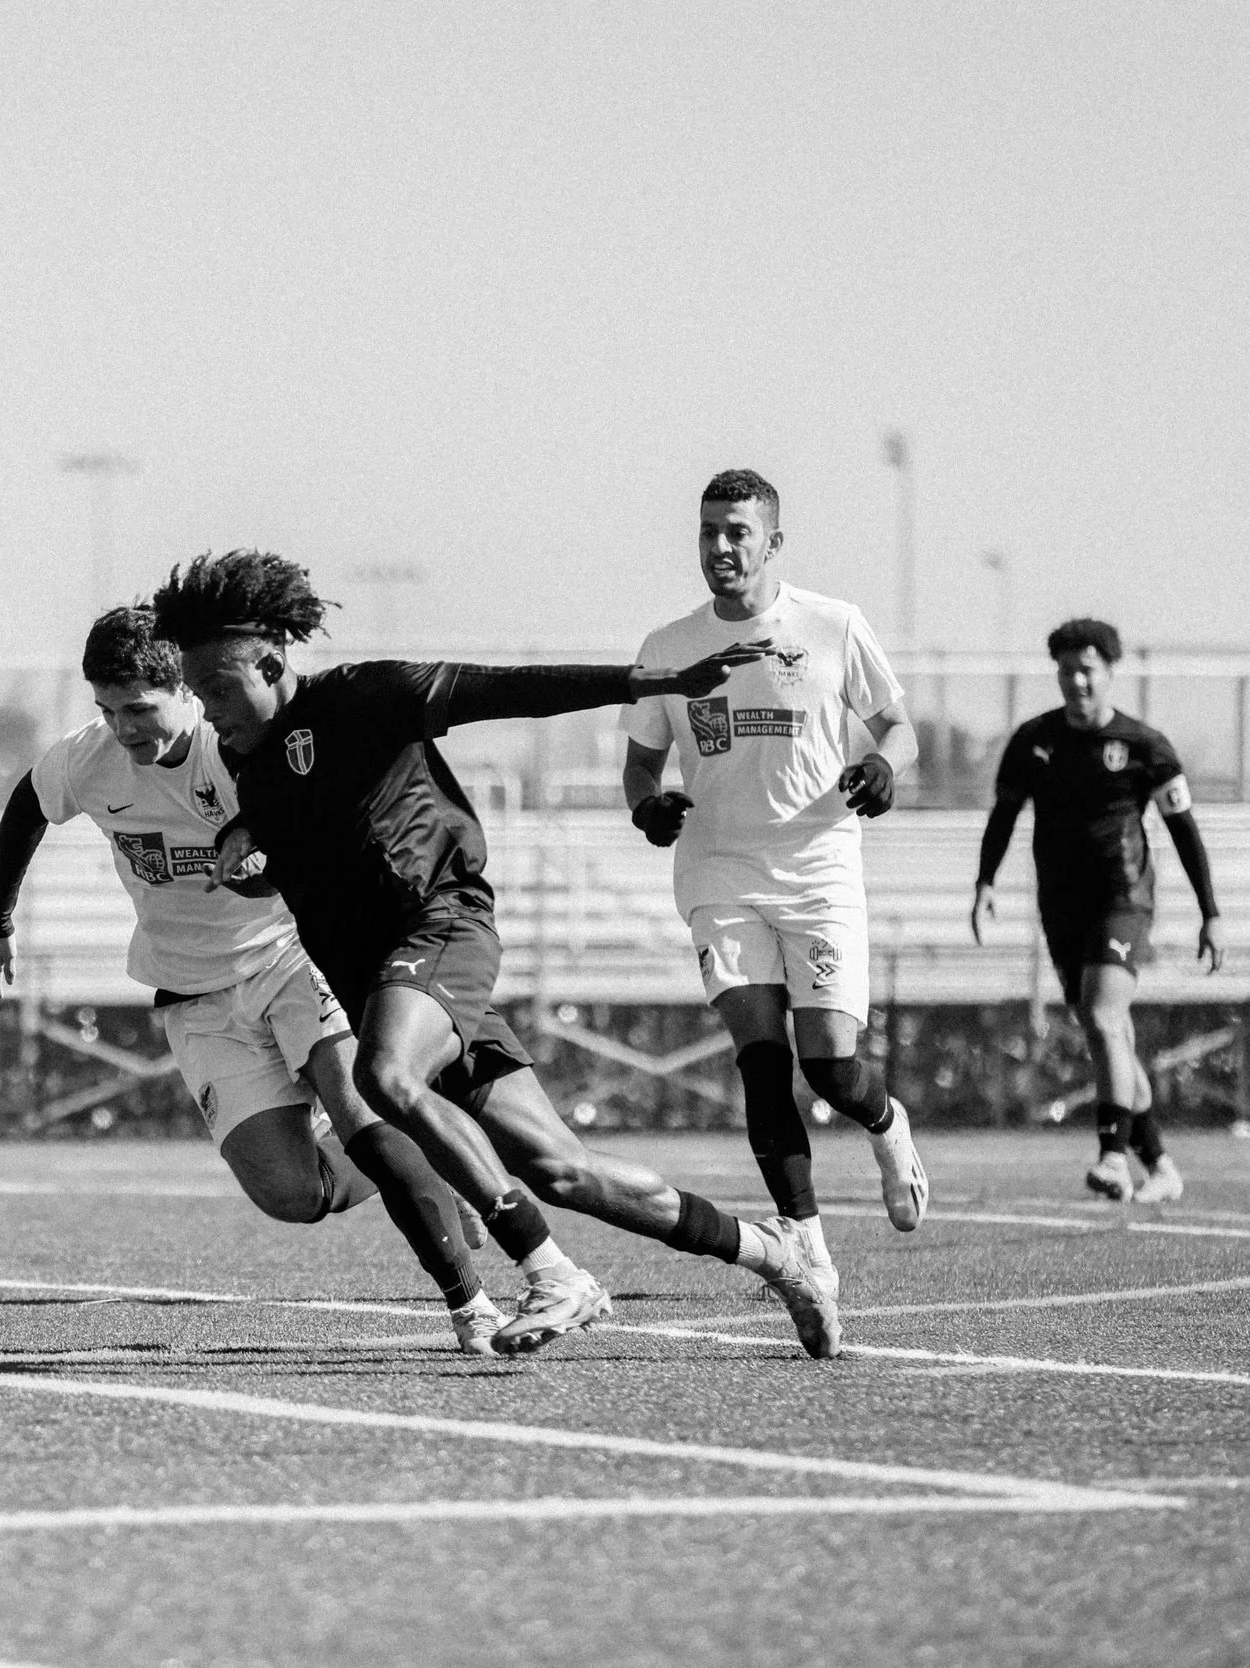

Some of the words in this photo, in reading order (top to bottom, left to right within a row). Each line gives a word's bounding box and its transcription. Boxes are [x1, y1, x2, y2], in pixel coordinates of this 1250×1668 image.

[736, 711, 774, 720] WEALTH
[737, 726, 800, 735] MANAGEMENT
[700, 737, 727, 753] RBC
[134, 863, 170, 882] RBC
